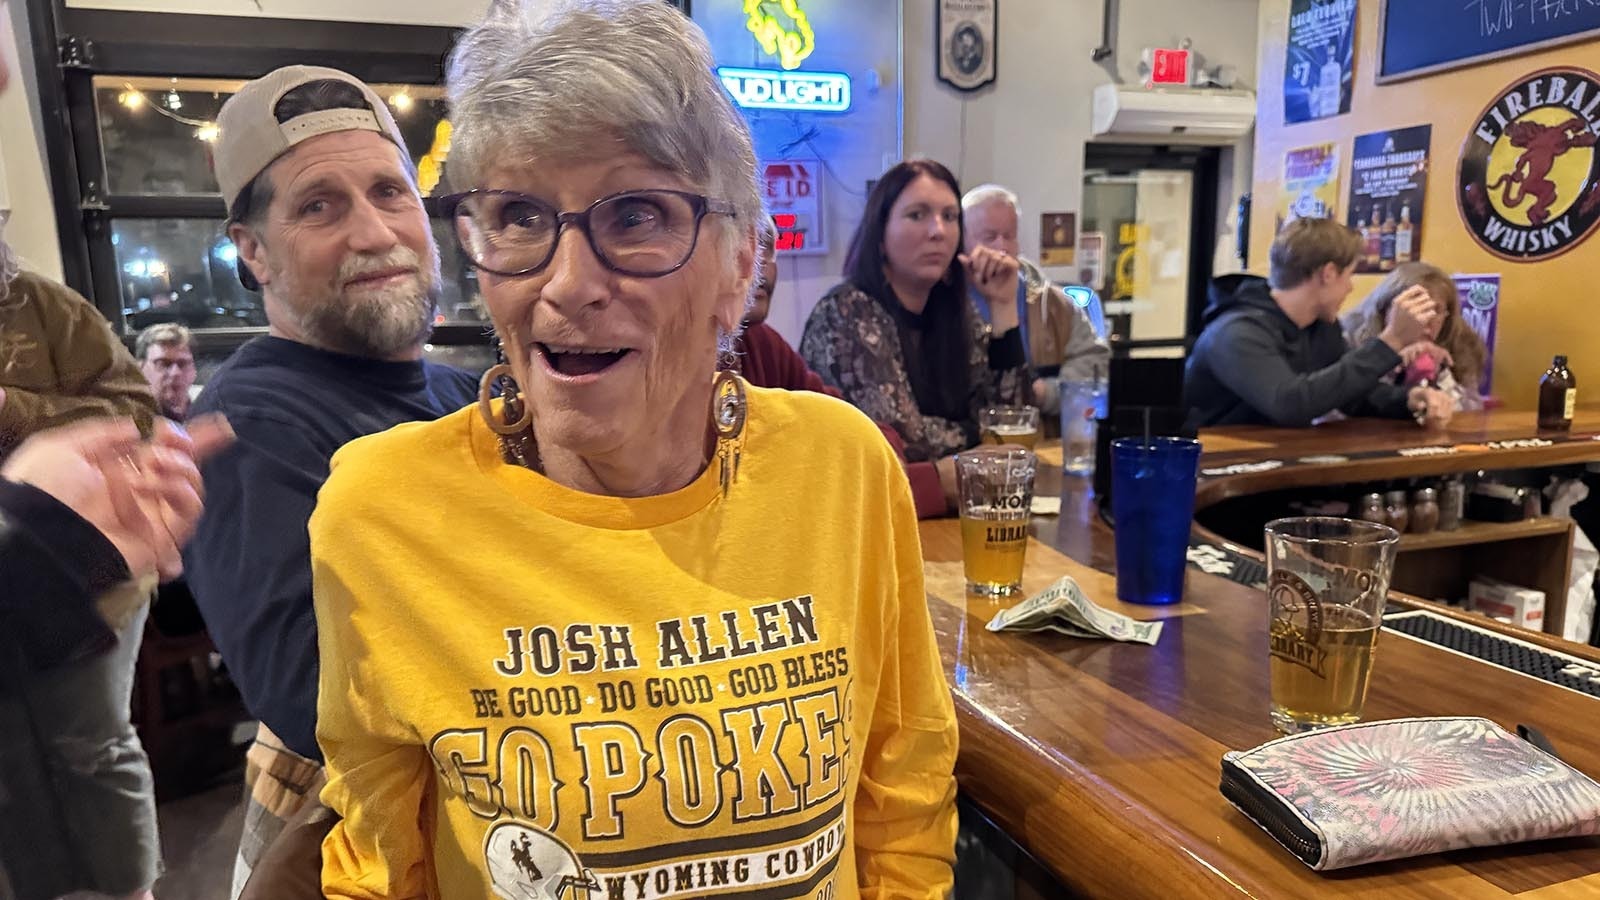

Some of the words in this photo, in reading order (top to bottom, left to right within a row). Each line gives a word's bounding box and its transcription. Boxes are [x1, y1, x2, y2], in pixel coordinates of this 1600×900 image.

[722, 77, 772, 103] UD
[773, 79, 844, 106] LIGHT
[1483, 215, 1573, 252] WHISKY
[494, 624, 639, 678] JOSH
[657, 595, 821, 668] ALLEN
[470, 688, 503, 719] BE
[508, 686, 583, 717] GOOD
[596, 679, 637, 714] DO
[646, 673, 713, 708] GOOD
[728, 663, 776, 698] GOD
[784, 647, 849, 690] BLESS
[430, 726, 565, 833] GO
[604, 857, 750, 900] WYOMING
